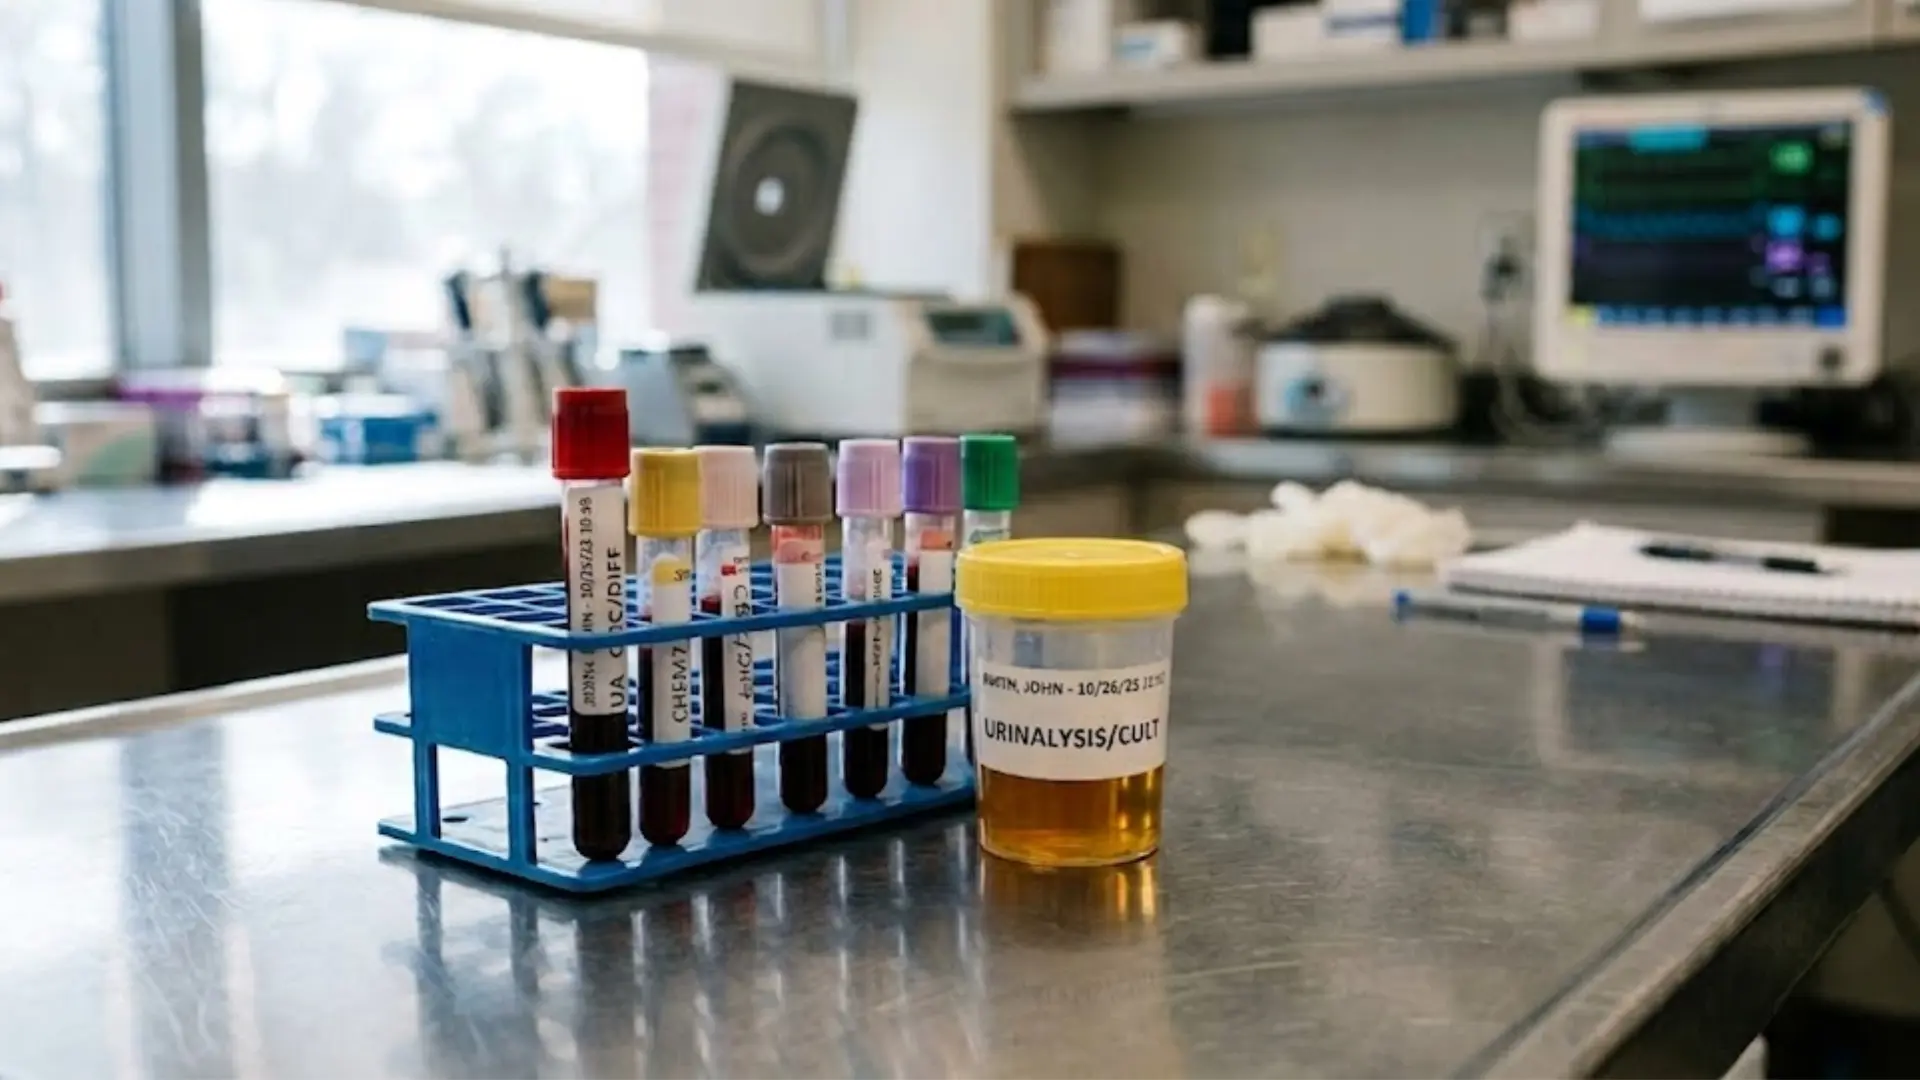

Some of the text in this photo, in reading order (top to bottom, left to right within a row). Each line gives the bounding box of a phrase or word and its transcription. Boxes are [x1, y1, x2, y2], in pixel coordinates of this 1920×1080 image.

[607, 547, 625, 707] UA CC/DIFF
[1024, 681, 1064, 695] JOHN
[1077, 679, 1139, 698] 10/26/25
[984, 718, 1160, 751] URINALYSIS/CULT
